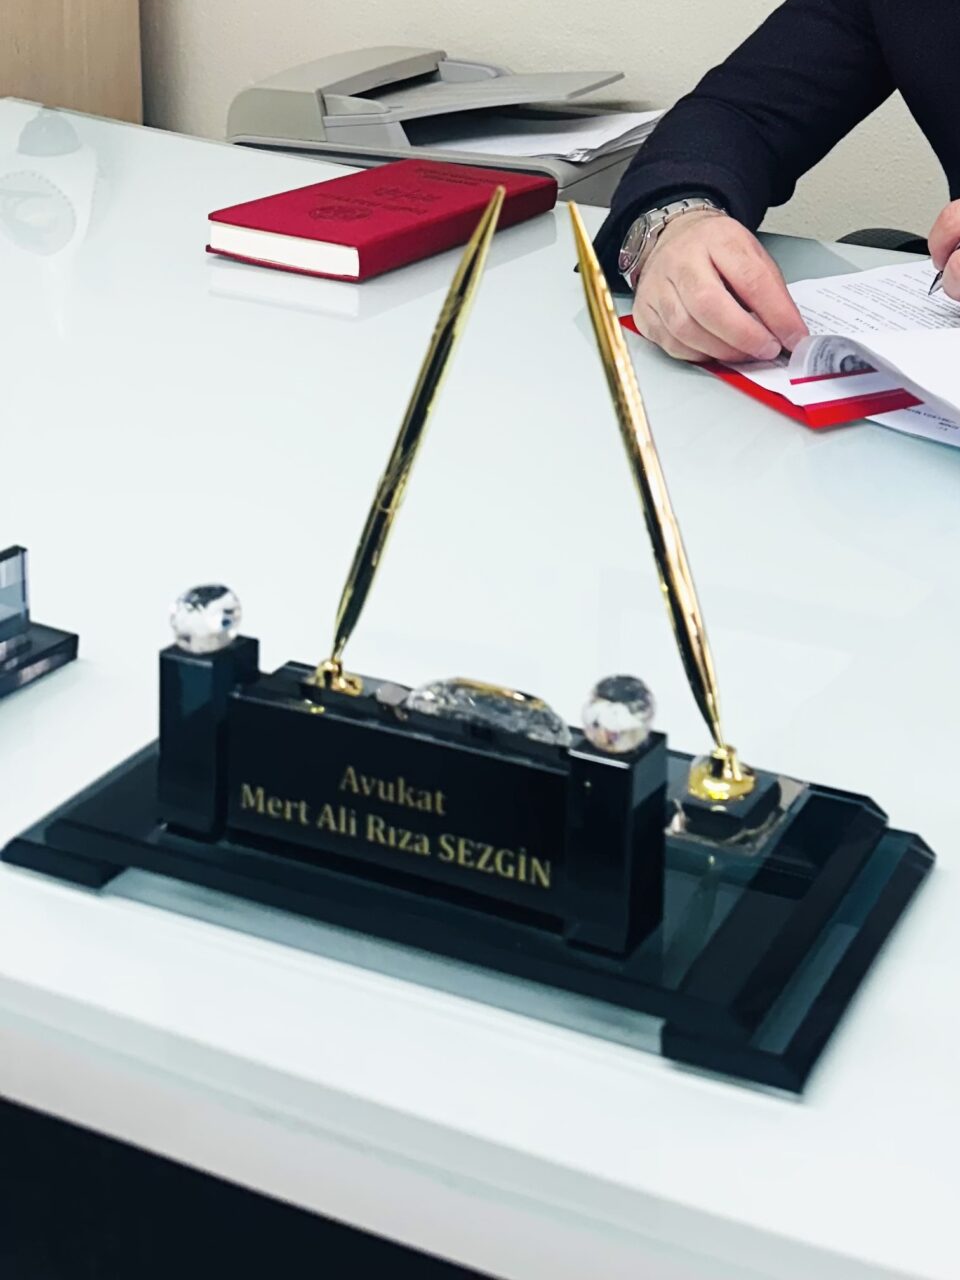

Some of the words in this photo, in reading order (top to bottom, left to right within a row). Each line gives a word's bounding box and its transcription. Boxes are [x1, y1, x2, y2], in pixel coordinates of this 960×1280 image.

[339, 765, 448, 817] Avukat
[240, 782, 310, 825] Mert
[317, 802, 357, 838] Ali
[365, 812, 431, 856] Rıza
[438, 831, 552, 889] SEZGİN
